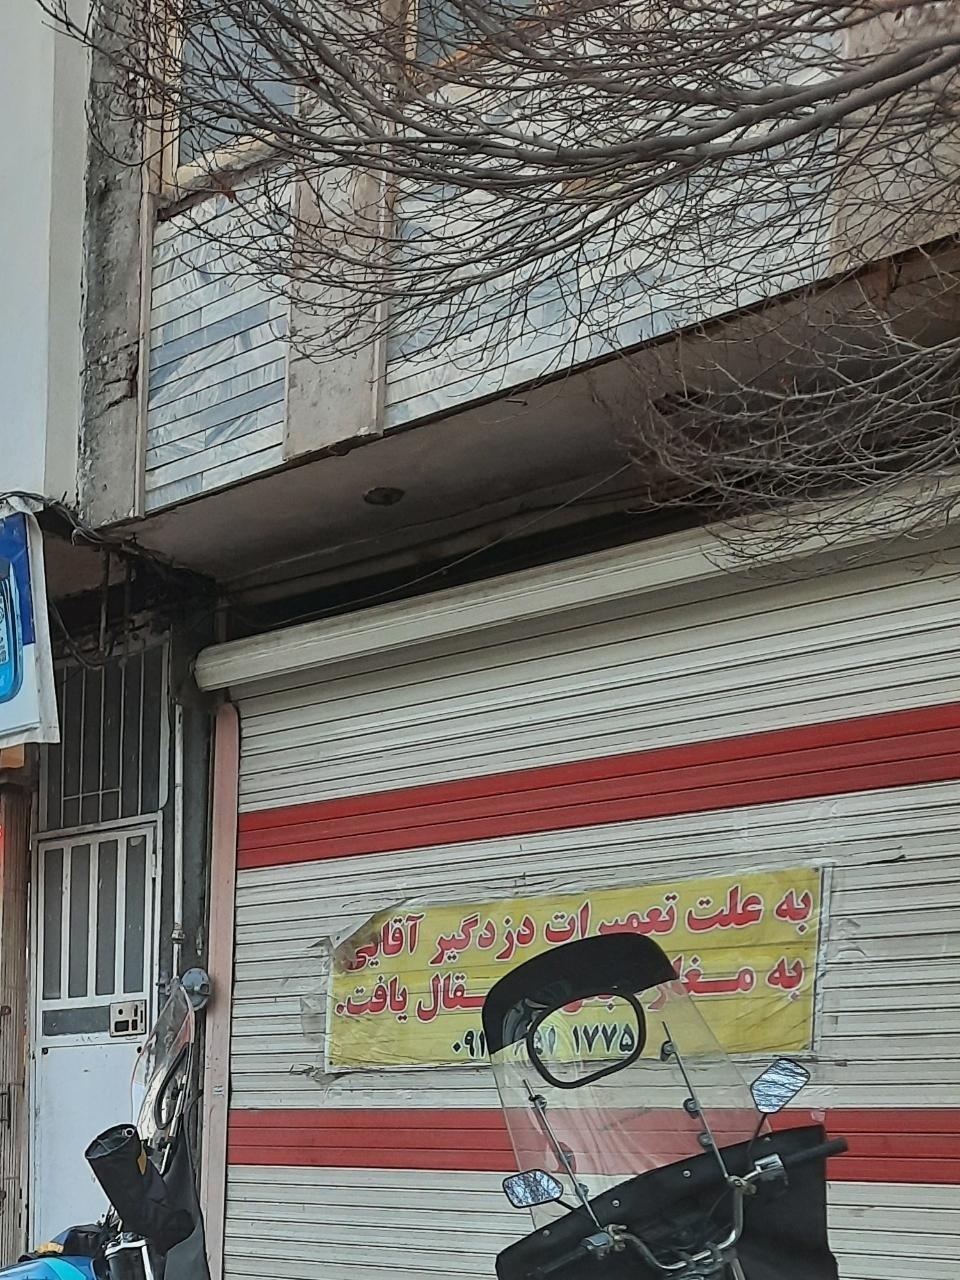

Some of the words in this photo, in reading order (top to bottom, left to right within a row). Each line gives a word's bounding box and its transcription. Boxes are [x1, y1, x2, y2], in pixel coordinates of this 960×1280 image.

[686, 886, 763, 932] علت
[773, 887, 813, 934] به
[347, 913, 425, 971] آقایی
[431, 911, 536, 966] دزدگیر
[766, 956, 805, 1001] به
